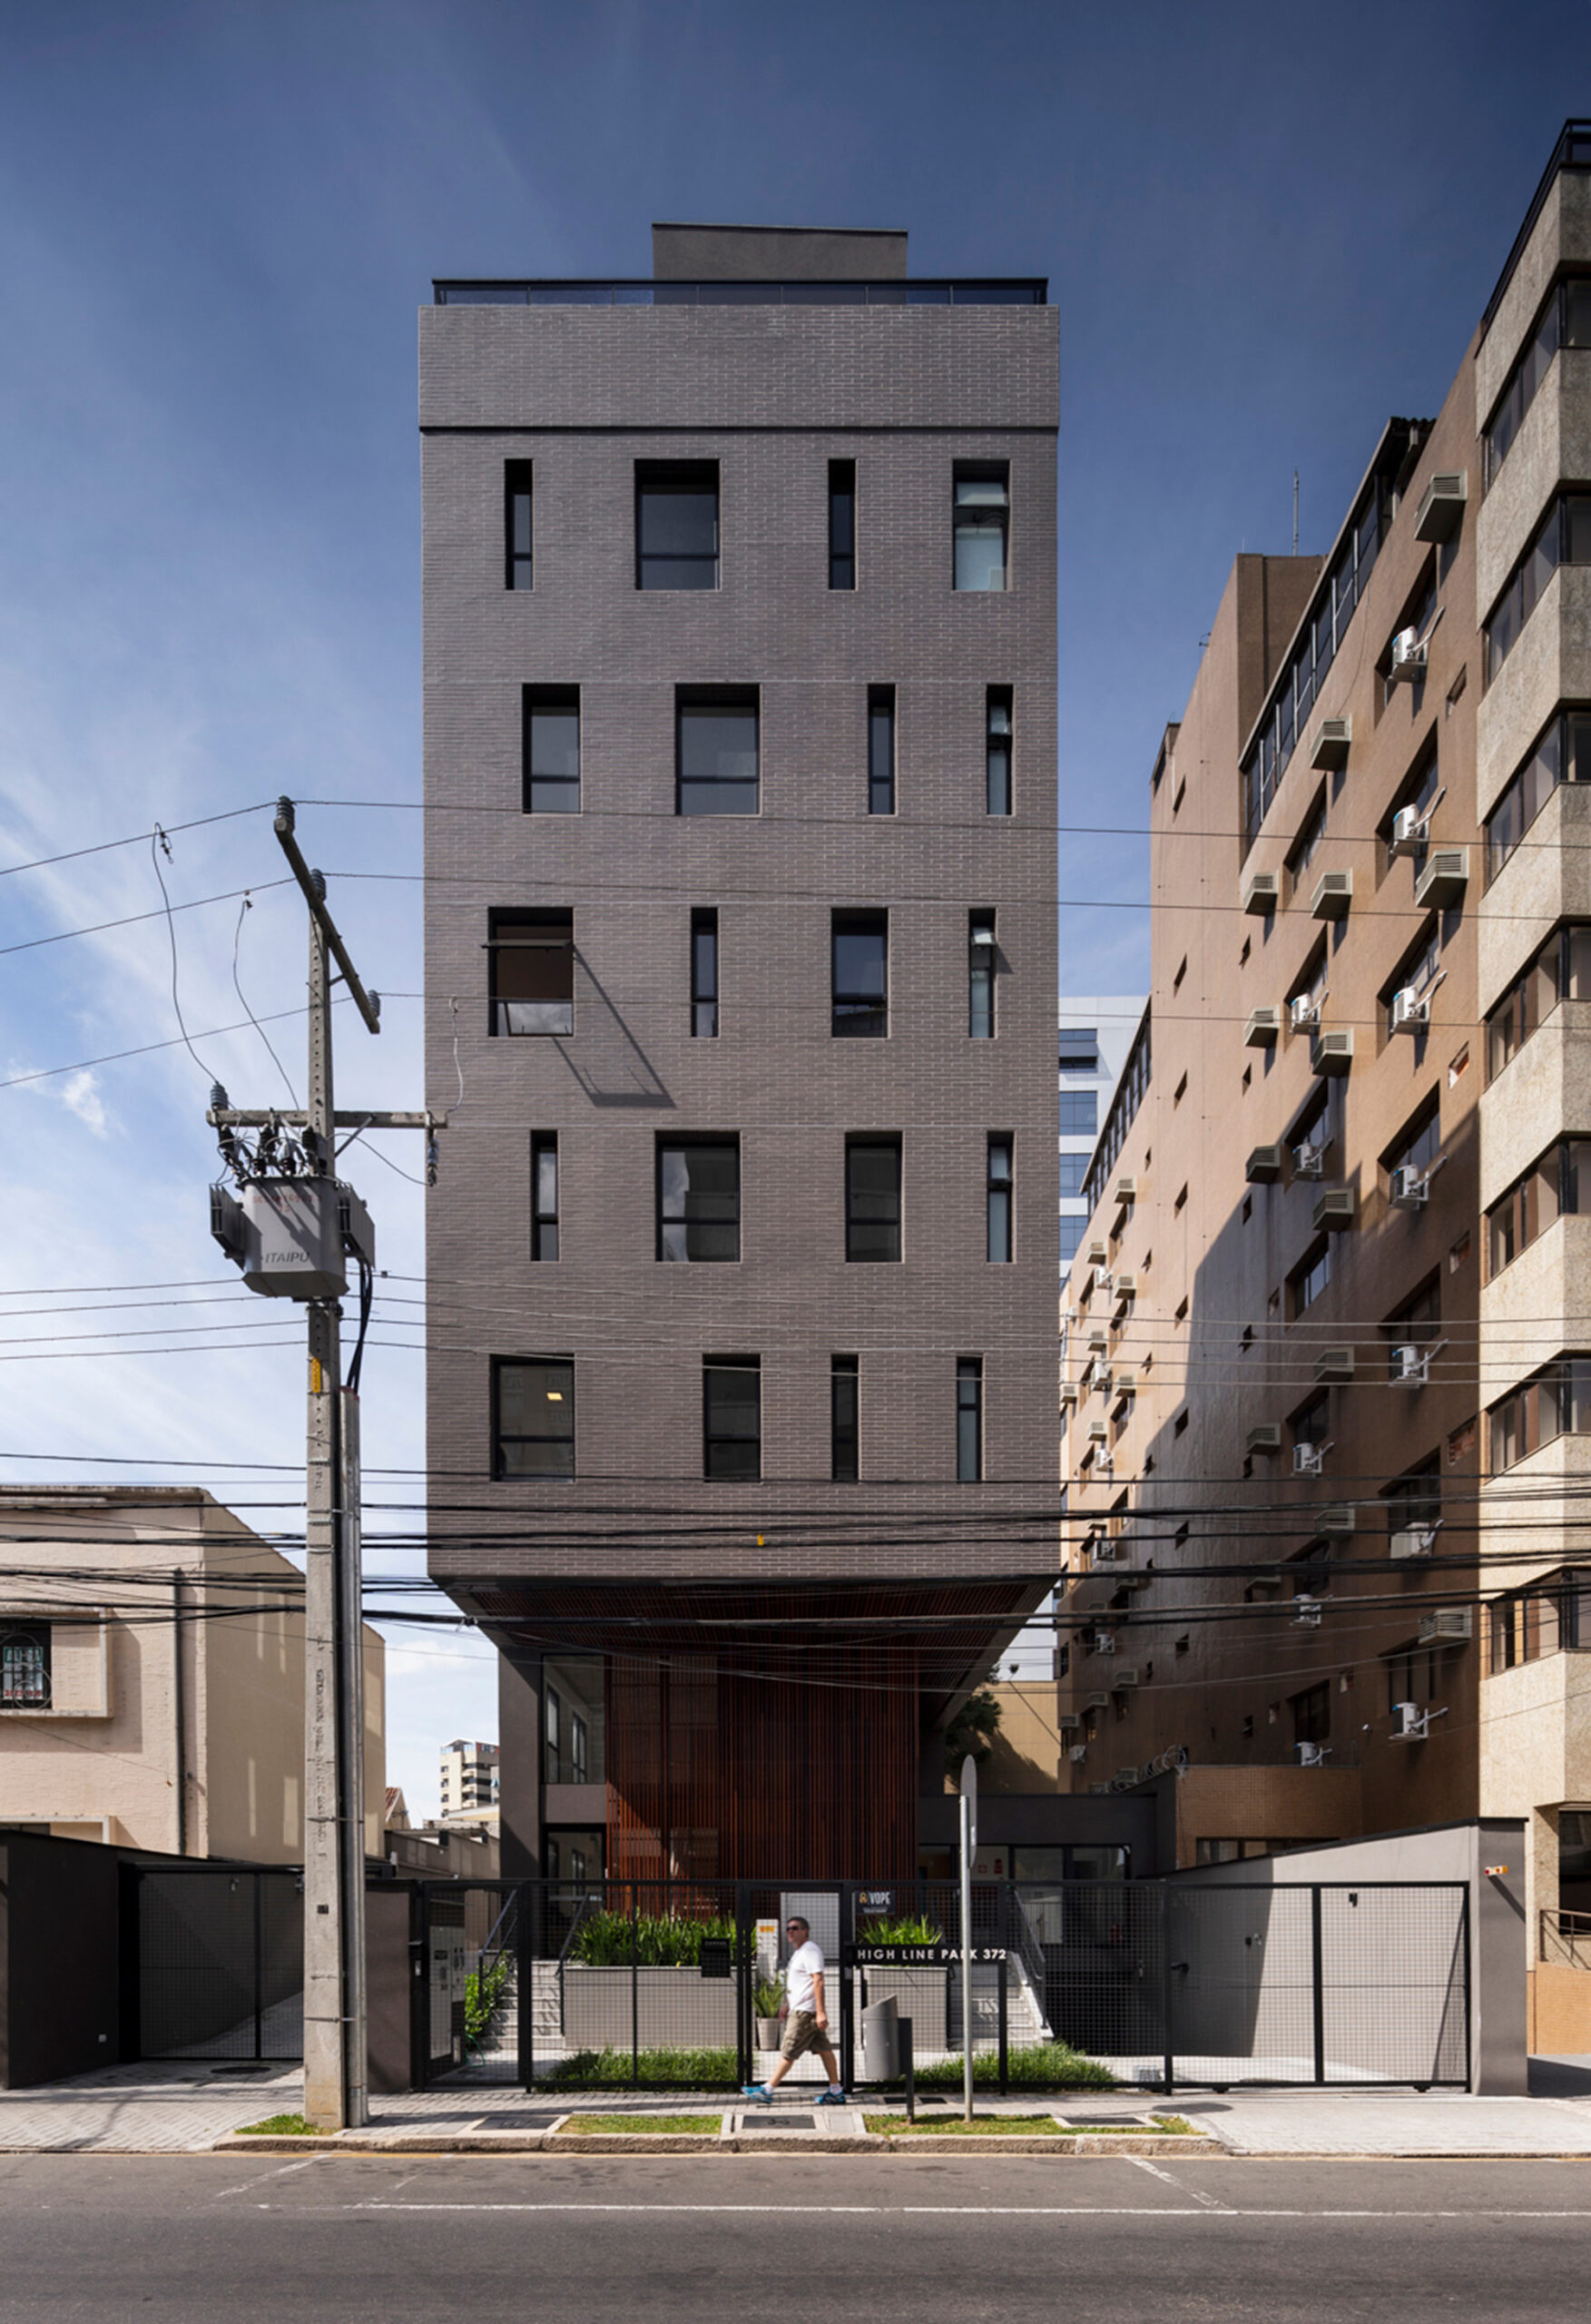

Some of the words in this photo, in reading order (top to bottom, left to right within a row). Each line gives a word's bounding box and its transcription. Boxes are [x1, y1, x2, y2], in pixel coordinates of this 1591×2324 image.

[265, 1251, 309, 1263] ITAIPU
[857, 1949, 895, 1960] HIGH
[902, 1949, 935, 1960] LINE
[982, 1948, 1007, 1960] 372
